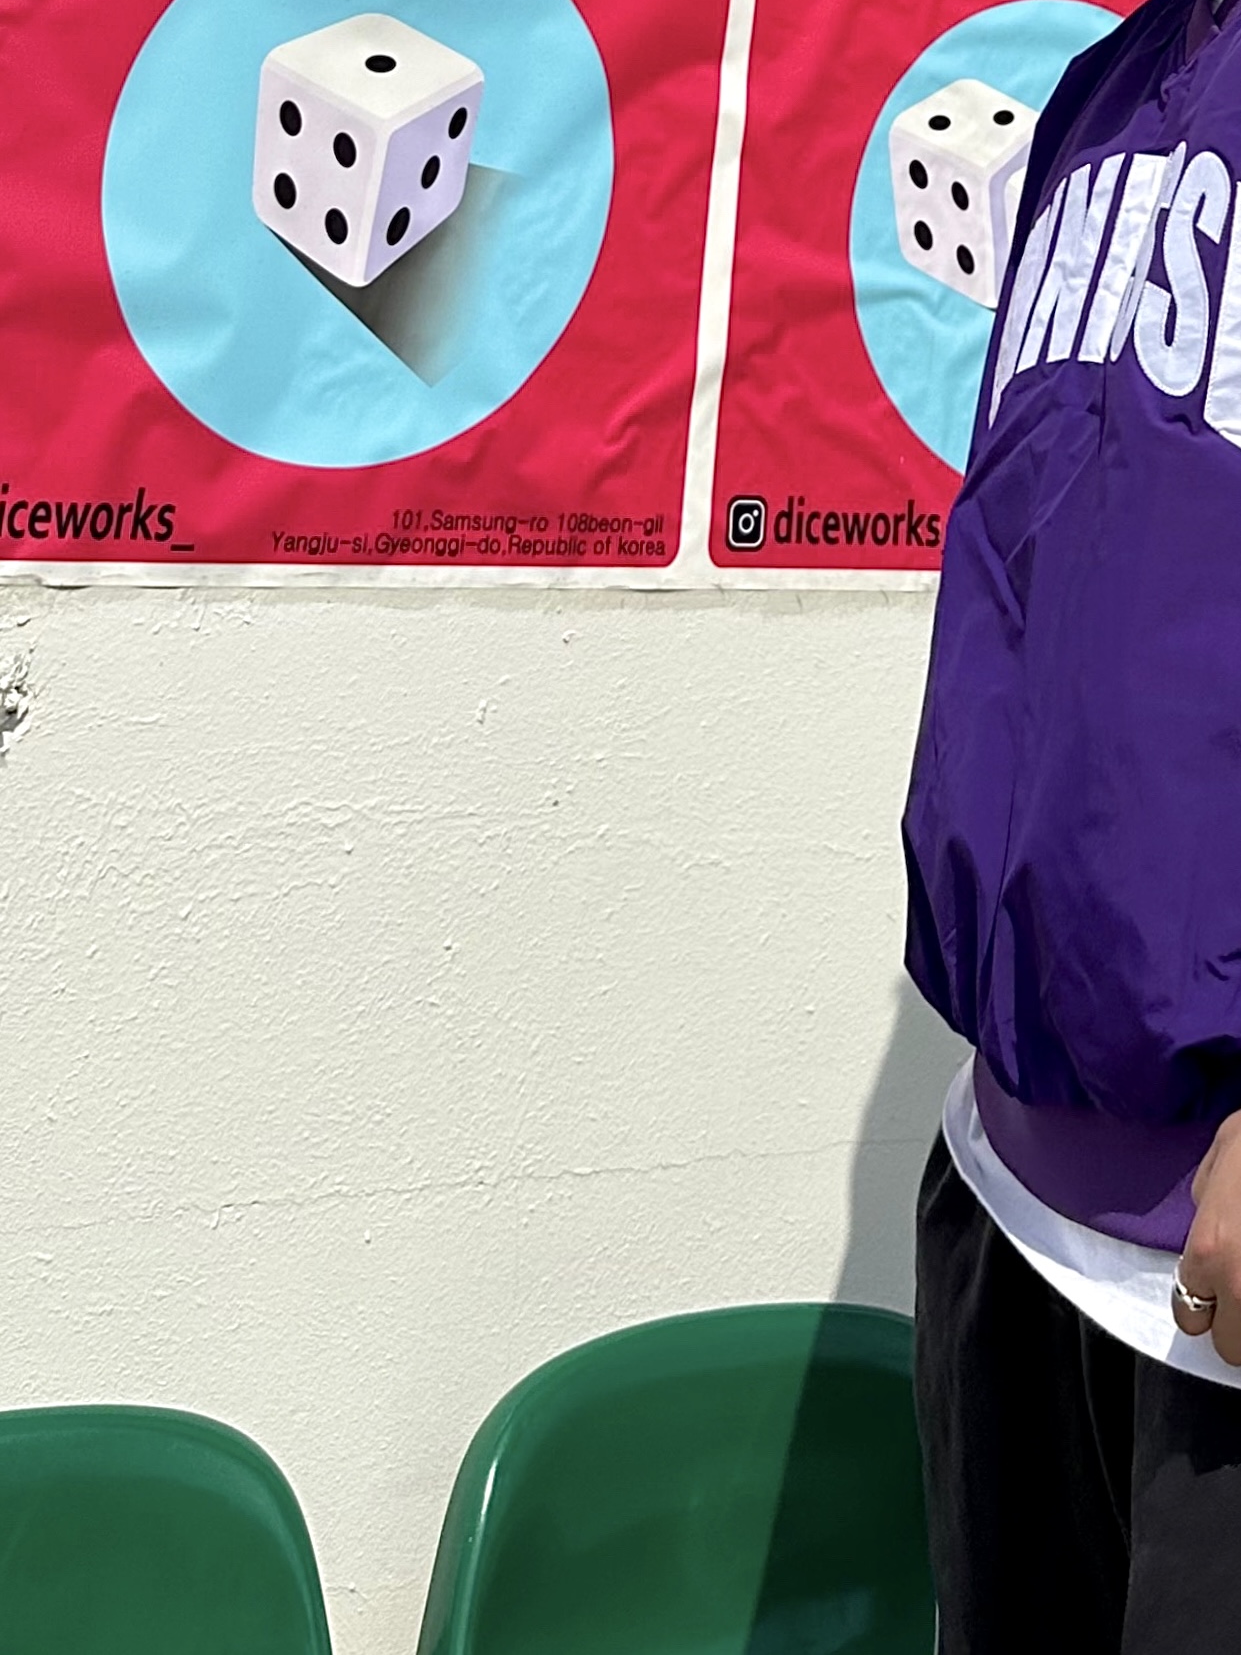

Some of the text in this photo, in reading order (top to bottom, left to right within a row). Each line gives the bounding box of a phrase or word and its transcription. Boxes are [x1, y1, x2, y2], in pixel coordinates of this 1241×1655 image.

[0, 482, 195, 552] iceworks_
[557, 512, 665, 536] 108beon-gil
[773, 495, 943, 553] diceworks
[593, 536, 612, 555] of
